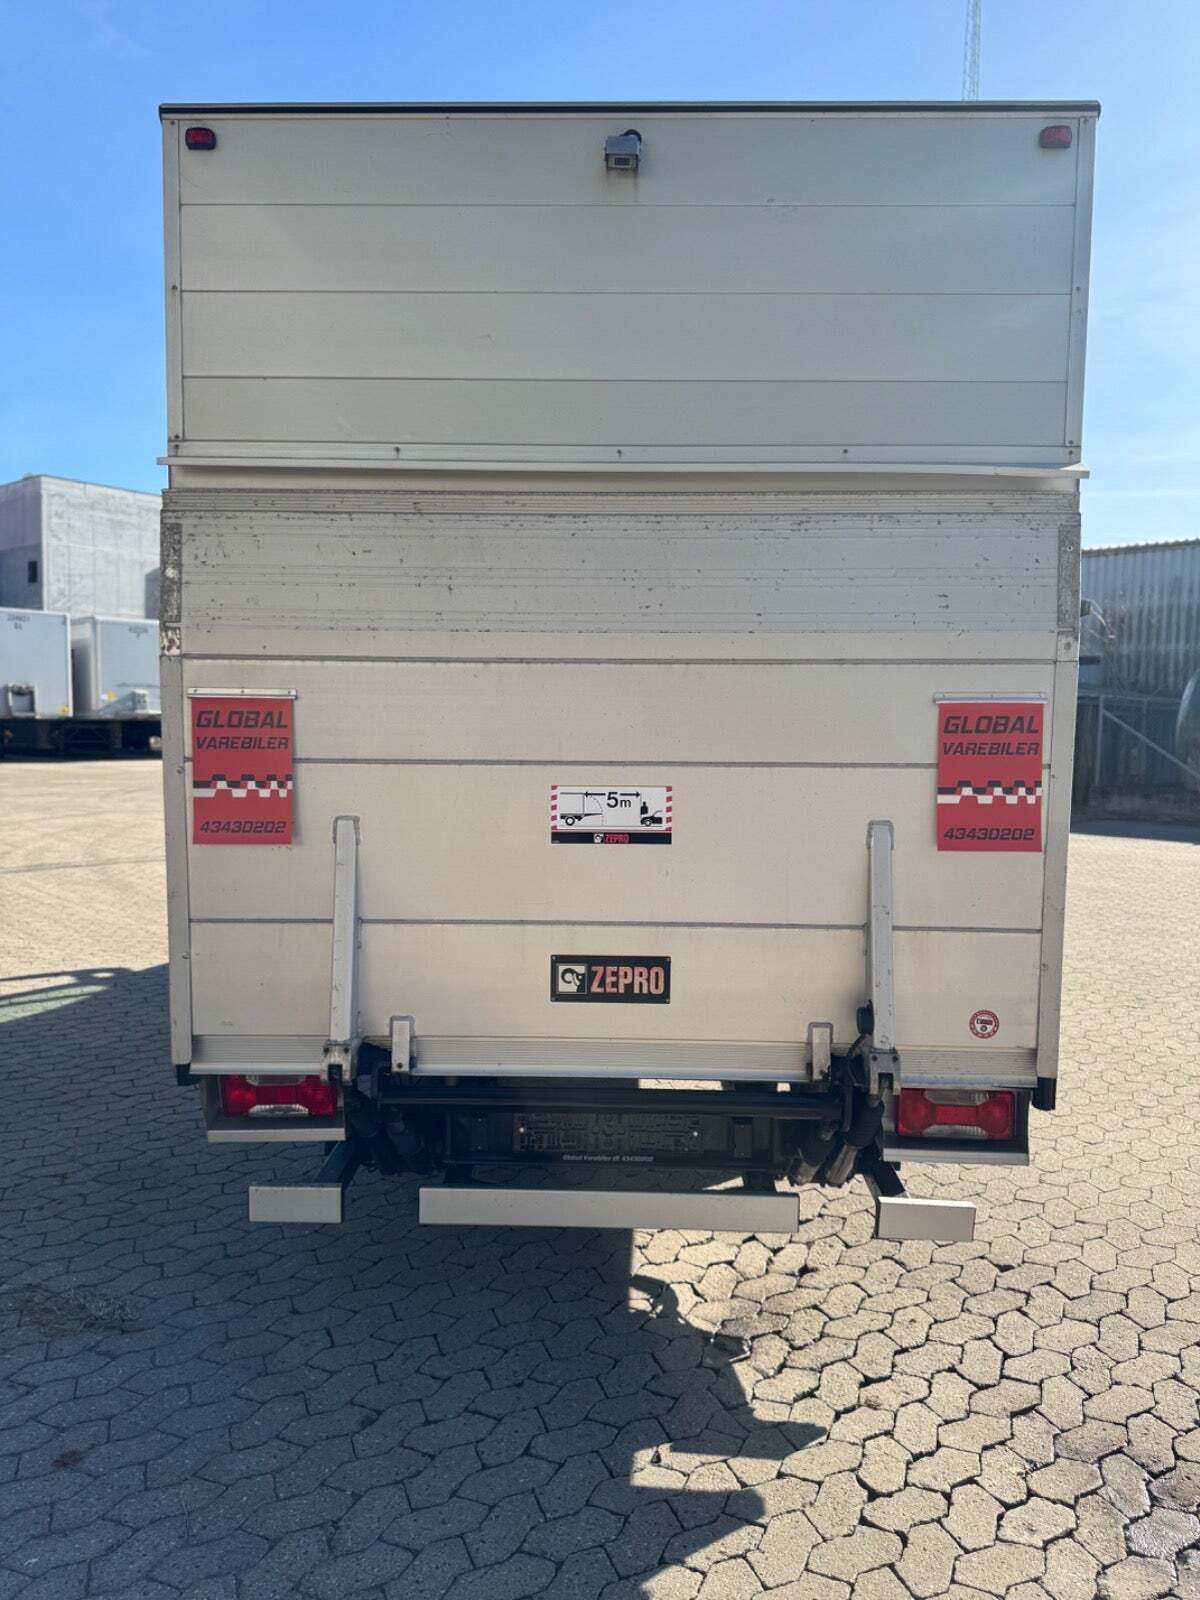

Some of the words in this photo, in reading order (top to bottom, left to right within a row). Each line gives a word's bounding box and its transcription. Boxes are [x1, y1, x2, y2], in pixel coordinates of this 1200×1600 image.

[196, 710, 288, 729] GLOBAL
[943, 715, 1039, 734] GLOBAL
[195, 736, 288, 750] VAREBILER
[943, 742, 1040, 756] VAREBILER
[200, 820, 287, 834] 43430202
[943, 827, 1035, 841] 43430202
[605, 834, 630, 844] ZEPRO
[590, 966, 665, 995] ZEPRO
